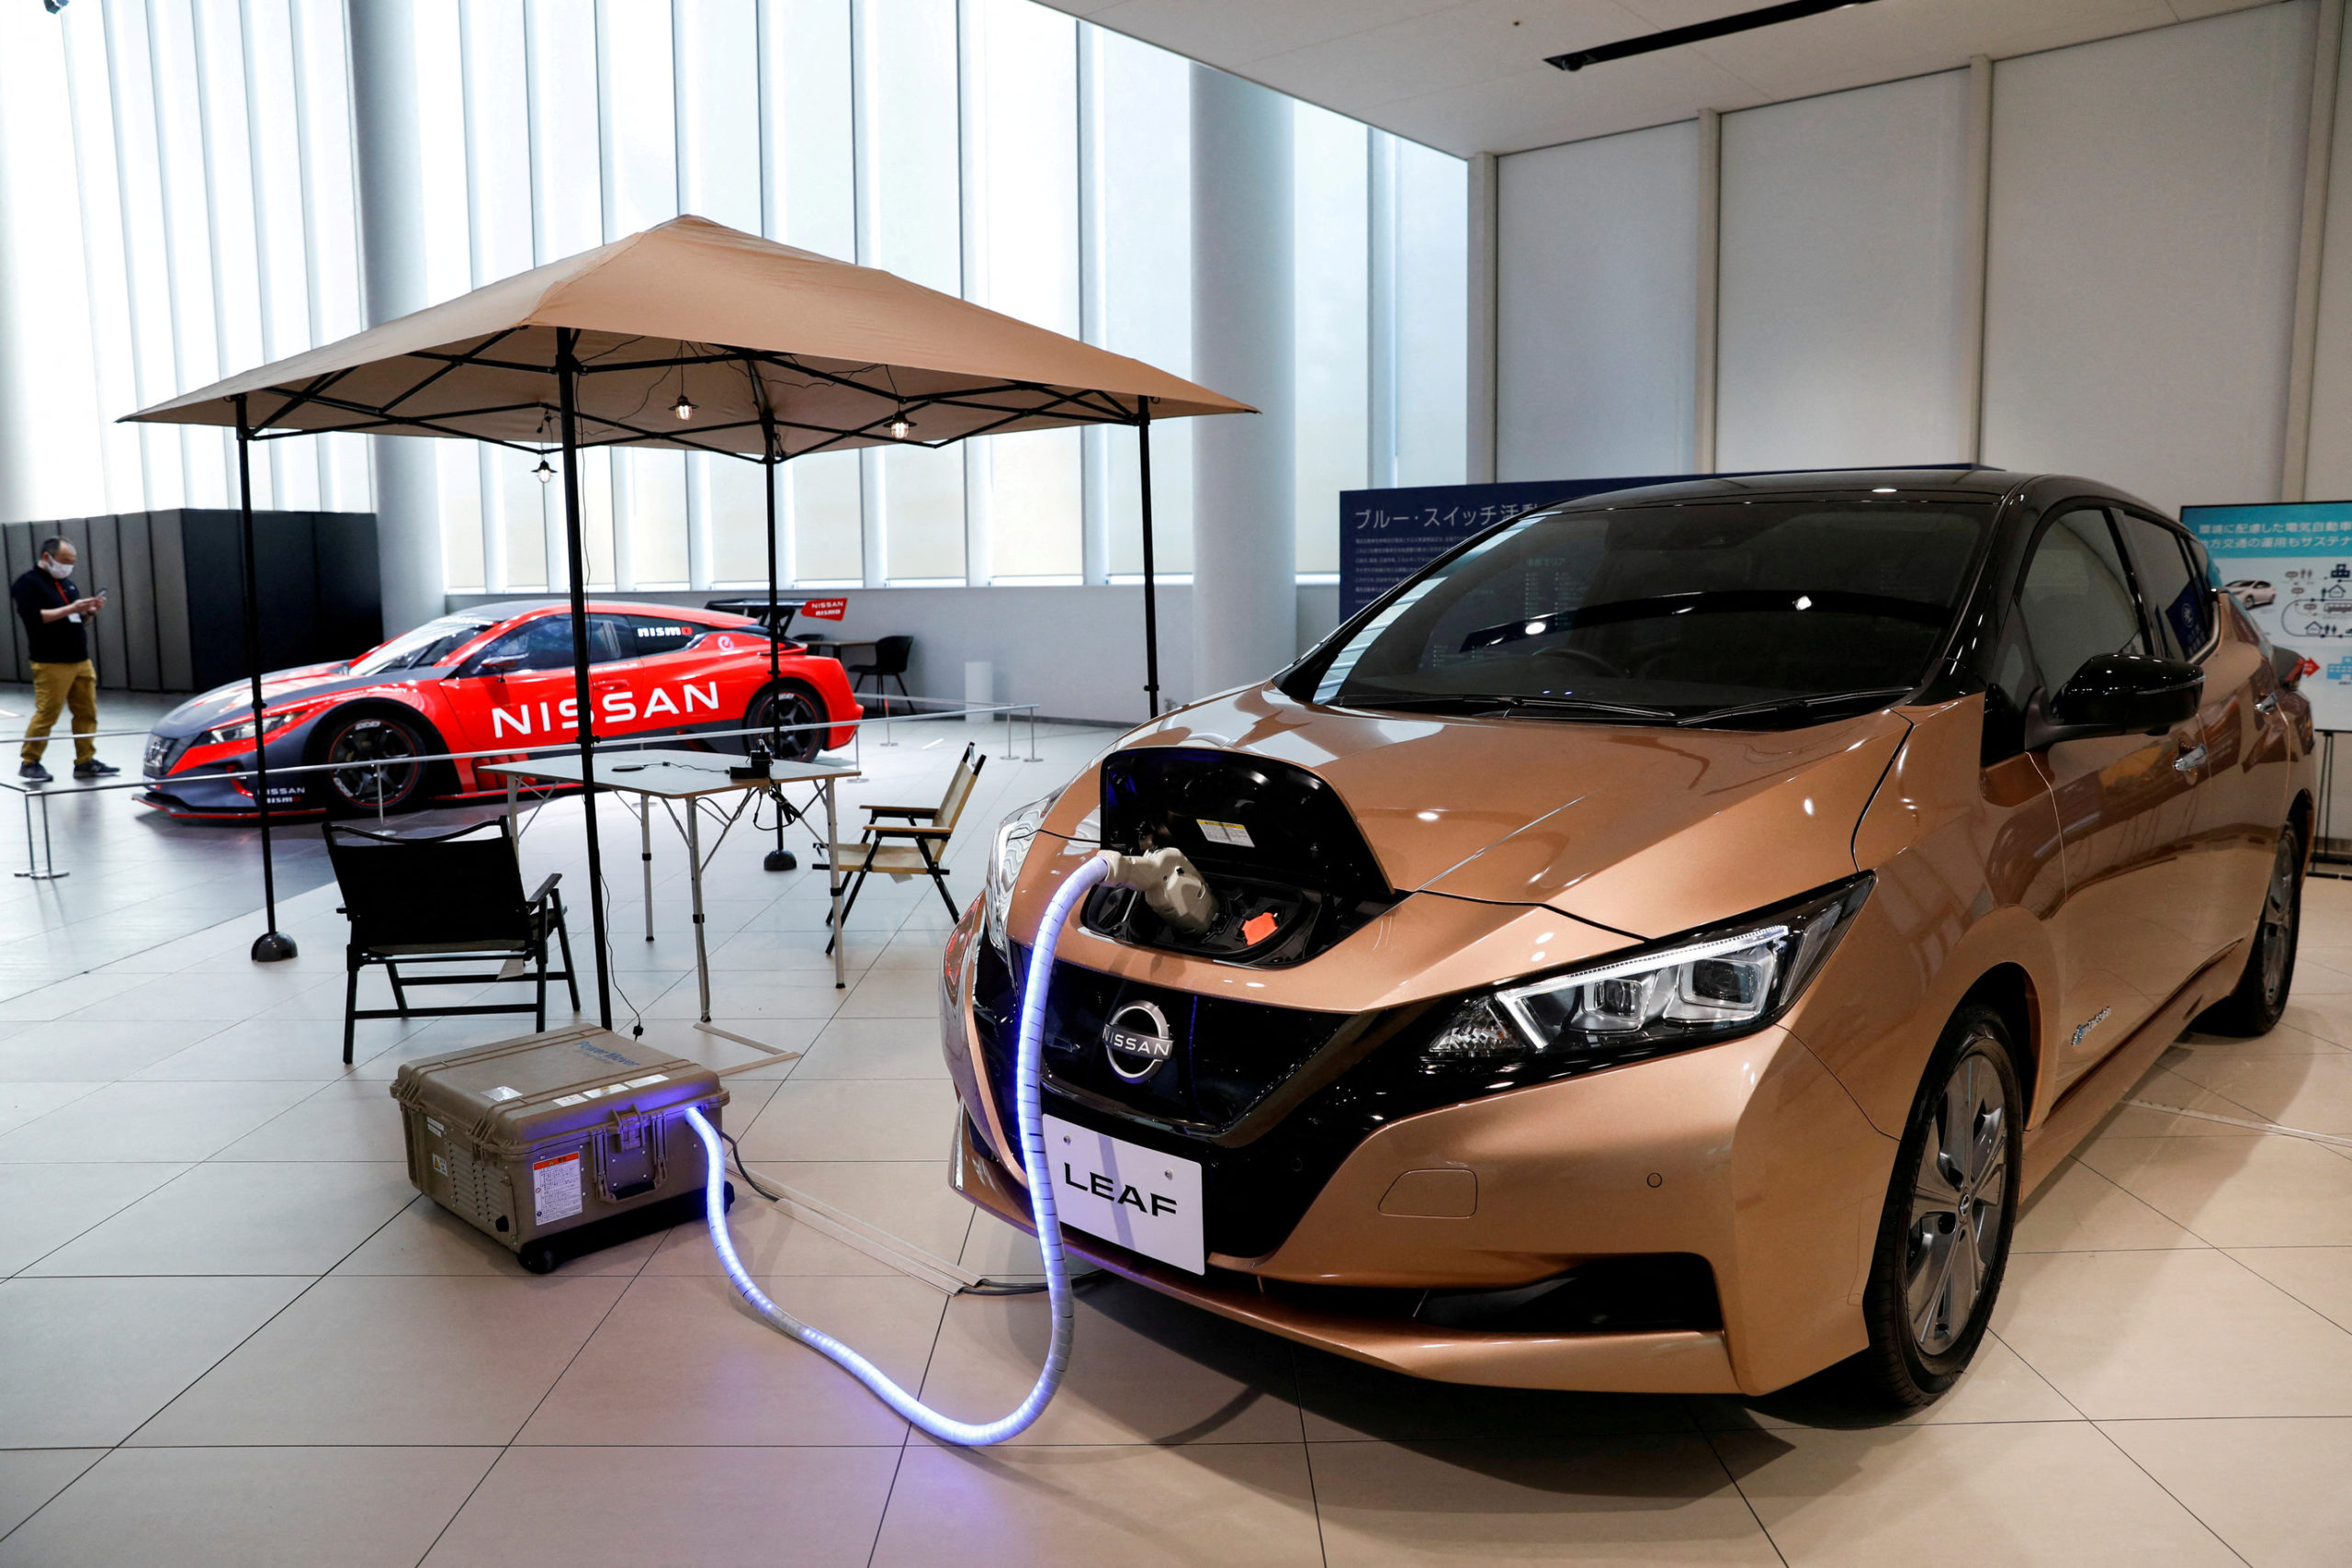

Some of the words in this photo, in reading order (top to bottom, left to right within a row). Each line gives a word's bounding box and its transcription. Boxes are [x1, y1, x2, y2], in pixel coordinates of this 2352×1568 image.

[811, 601, 844, 609] NISSAN
[257, 786, 306, 795] ISSAN
[1102, 1026, 1170, 1056] NISSAN
[1063, 1162, 1178, 1217] LEAF
